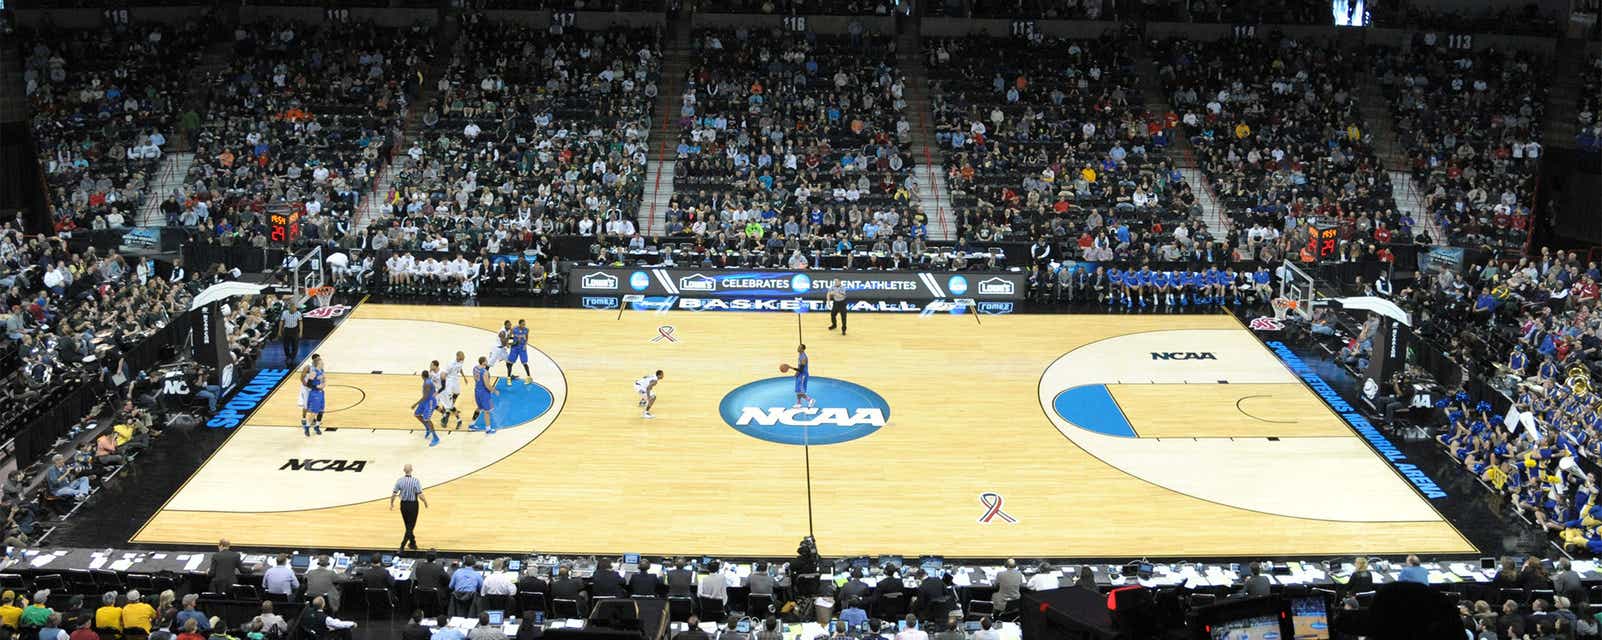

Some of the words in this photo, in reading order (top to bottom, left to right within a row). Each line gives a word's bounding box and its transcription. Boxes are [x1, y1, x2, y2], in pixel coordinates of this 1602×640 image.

[553, 13, 575, 27] 117
[1448, 34, 1472, 49] 113
[271, 225, 285, 241] 29
[1321, 240, 1335, 256] 29
[721, 279, 790, 289] CELEBRATES
[1149, 351, 1219, 361] NCAA
[163, 379, 190, 395] NC
[206, 368, 290, 428] SPOKANE
[735, 406, 887, 427] NCAA
[1301, 372, 1355, 413] VETERANS
[1342, 413, 1408, 462] MEMORIAL
[1393, 462, 1448, 499] ARENA
[278, 458, 368, 473] NCAA
